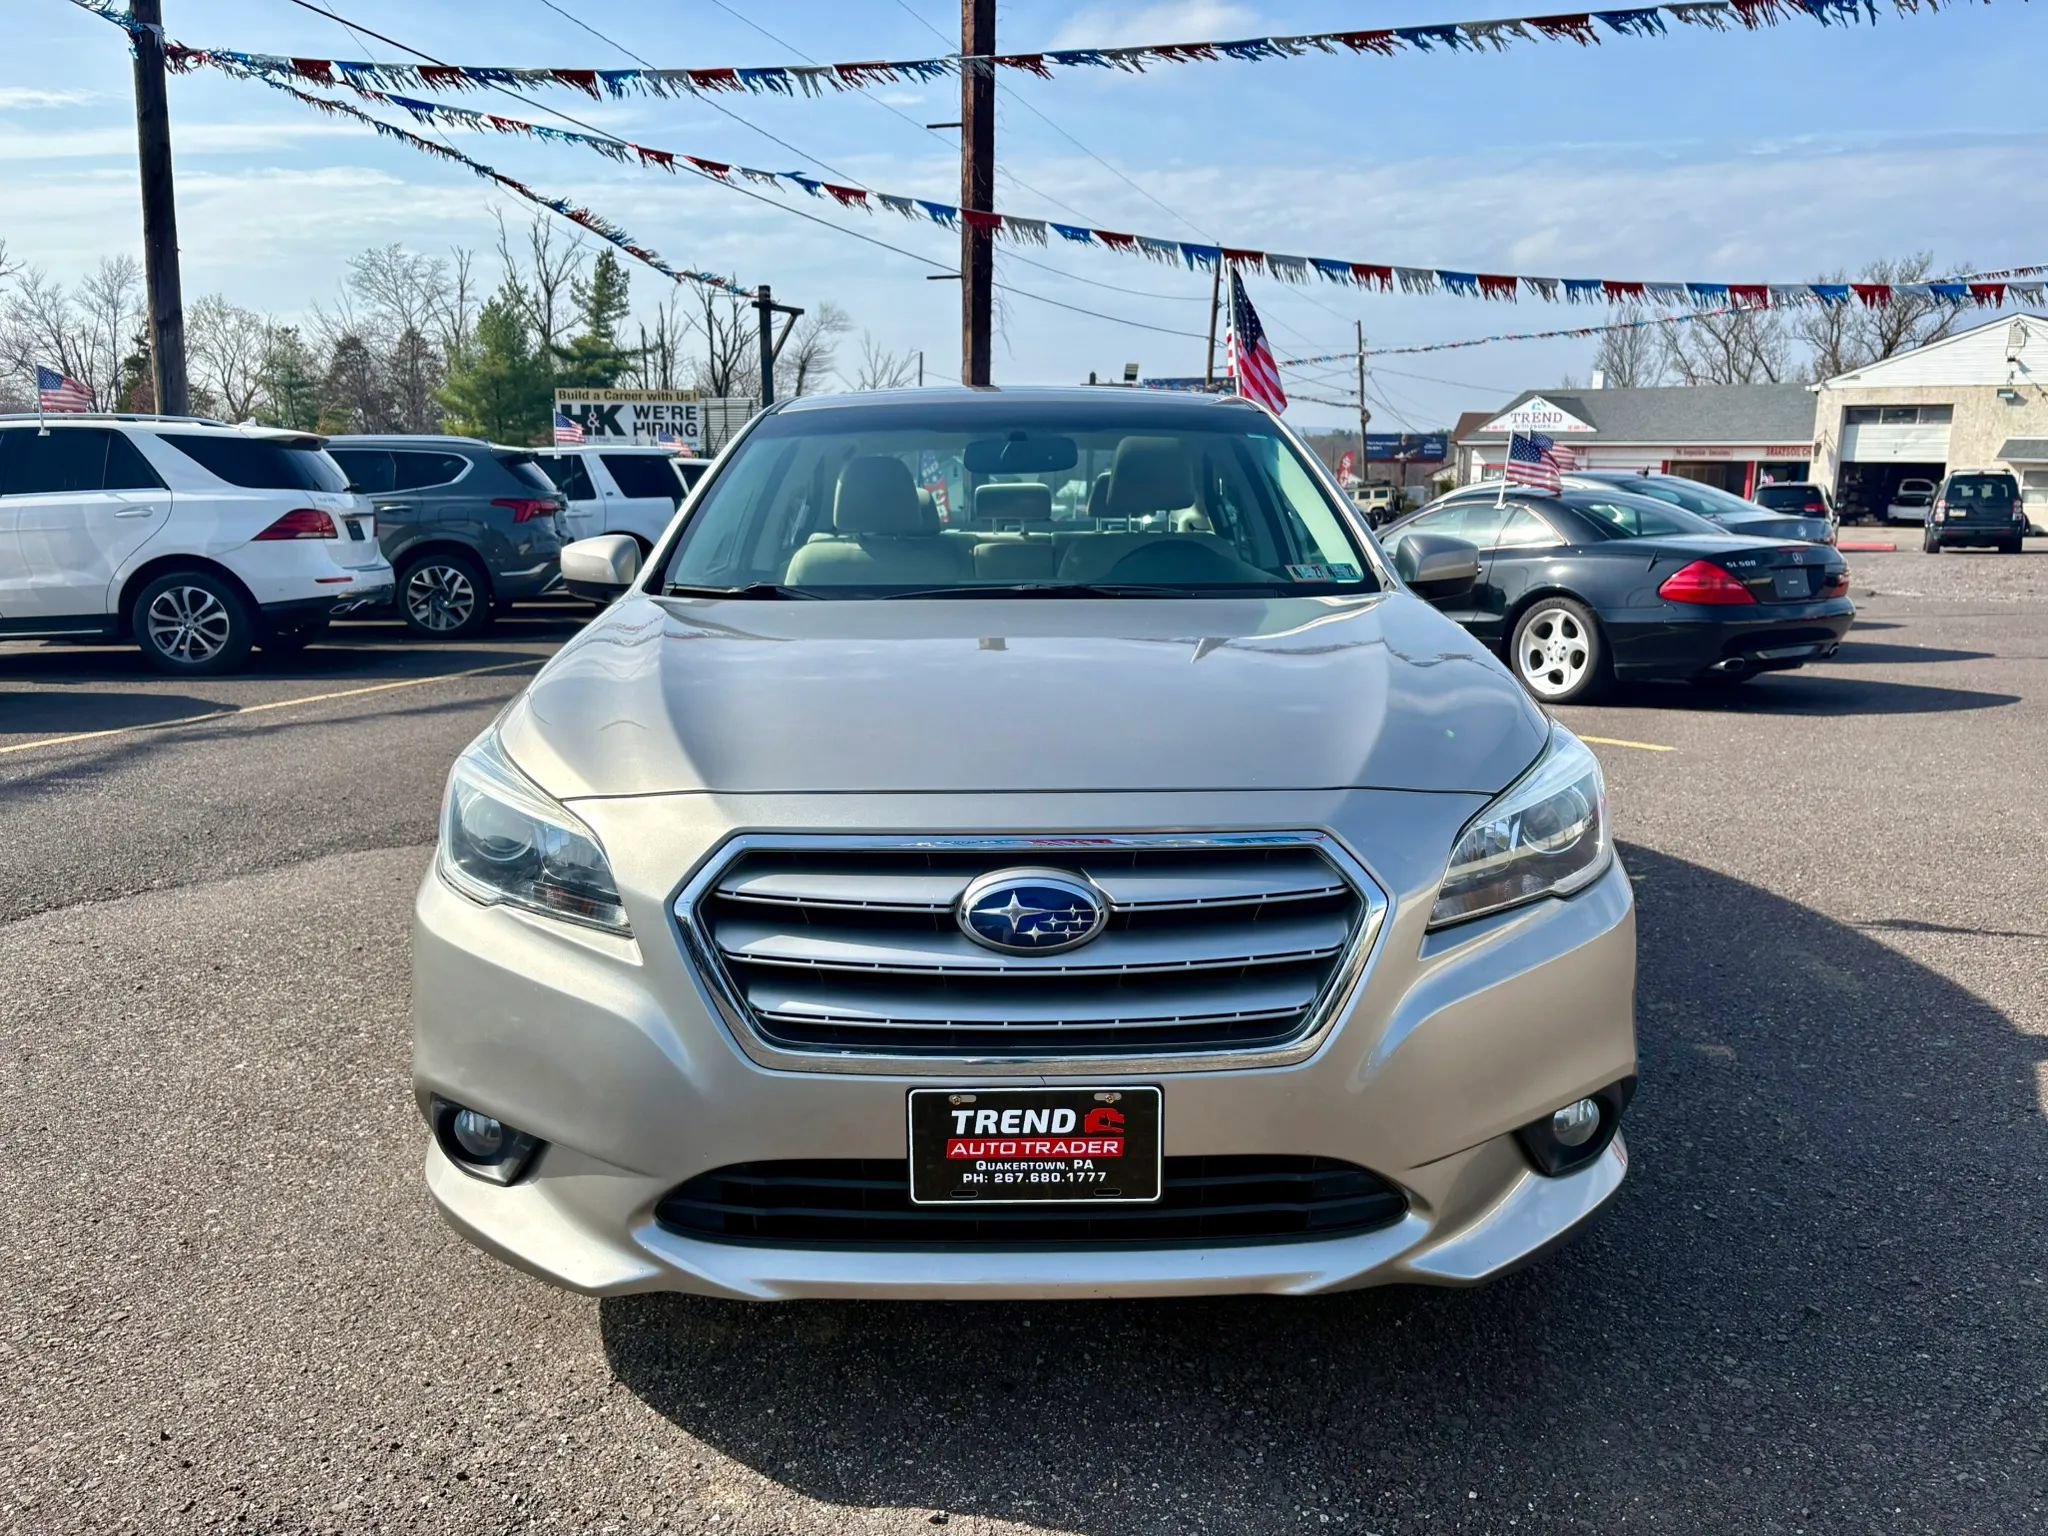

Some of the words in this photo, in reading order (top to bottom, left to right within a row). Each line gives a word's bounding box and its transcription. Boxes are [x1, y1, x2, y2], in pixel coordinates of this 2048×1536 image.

[558, 390, 590, 400] Build
[603, 391, 643, 401] Career
[648, 392, 672, 401] with
[1510, 412, 1563, 424] TREND
[633, 422, 697, 437] HIRING
[951, 1108, 1077, 1135] TREND
[950, 1142, 1017, 1156] AUTO
[1021, 1140, 1119, 1155] TRADER
[1073, 1159, 1094, 1170] PA
[963, 1173, 988, 1184] PH:
[994, 1171, 1107, 1184] 267.680.1777
